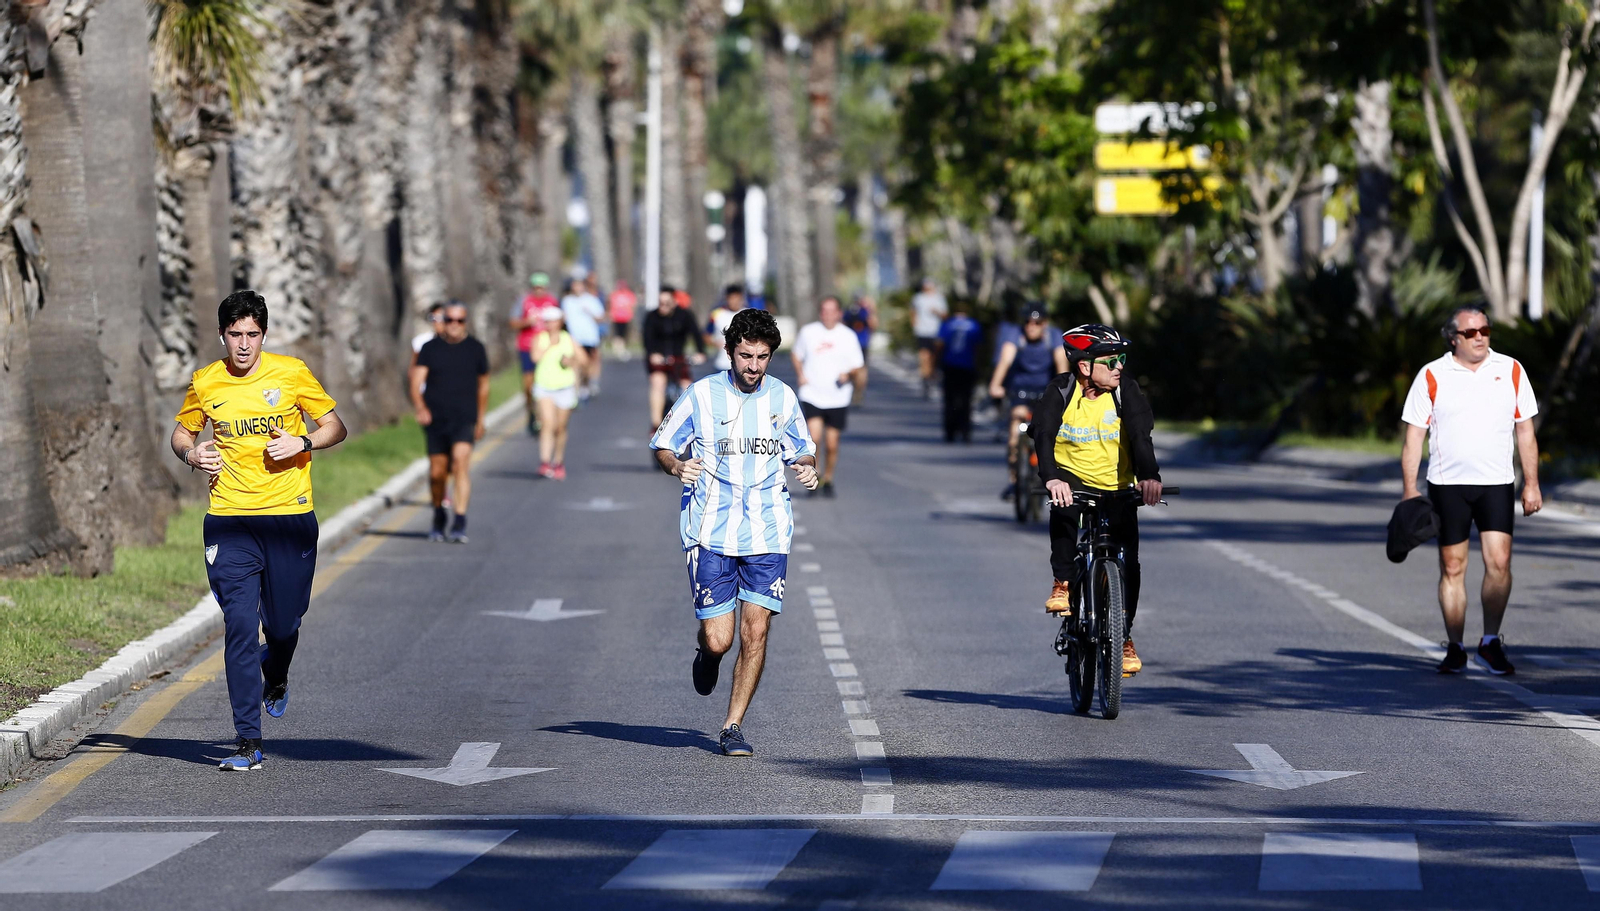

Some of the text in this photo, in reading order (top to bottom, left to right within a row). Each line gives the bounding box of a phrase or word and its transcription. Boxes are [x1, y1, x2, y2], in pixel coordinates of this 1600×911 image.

[235, 414, 284, 437] UNESCO
[739, 437, 780, 456] UNESCO
[769, 577, 786, 599] 46
